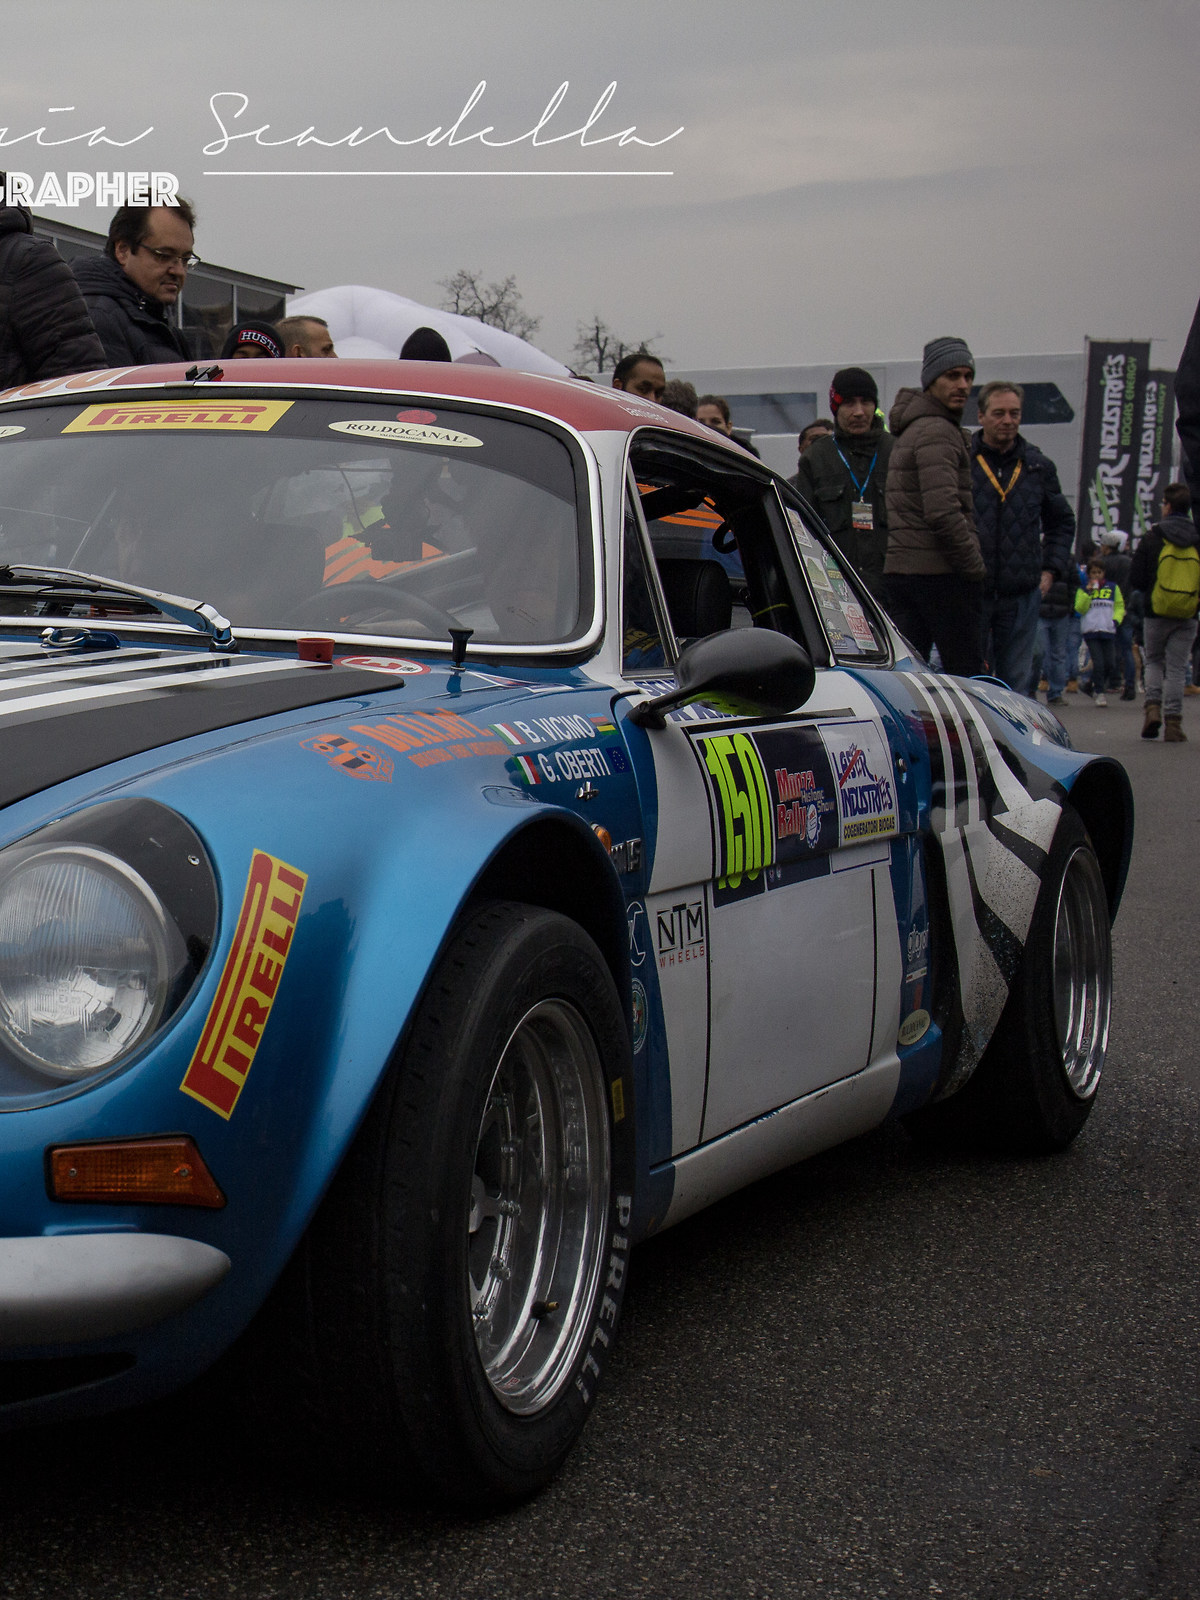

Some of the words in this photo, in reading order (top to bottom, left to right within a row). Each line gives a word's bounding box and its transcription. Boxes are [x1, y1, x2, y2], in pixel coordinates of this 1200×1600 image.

[1125, 356, 1137, 401] ENERGY
[87, 404, 268, 427] PIRELLI
[345, 423, 464, 443] ROLDOCANAL
[1121, 402, 1134, 446] BIOGAS
[514, 720, 544, 743] B.
[540, 714, 597, 742] VICINO
[537, 753, 559, 783] G.
[556, 747, 612, 780] OBERTI
[774, 767, 816, 802] Monza
[702, 733, 773, 888] 150
[840, 776, 893, 818] INDUSTRIES
[776, 801, 808, 841] Rally
[878, 817, 895, 832] BIOGAS
[656, 901, 704, 954] NTM
[659, 946, 705, 968] WHEELS
[183, 853, 305, 1115] PIRELLI
[574, 1195, 632, 1405] PIRELLI
